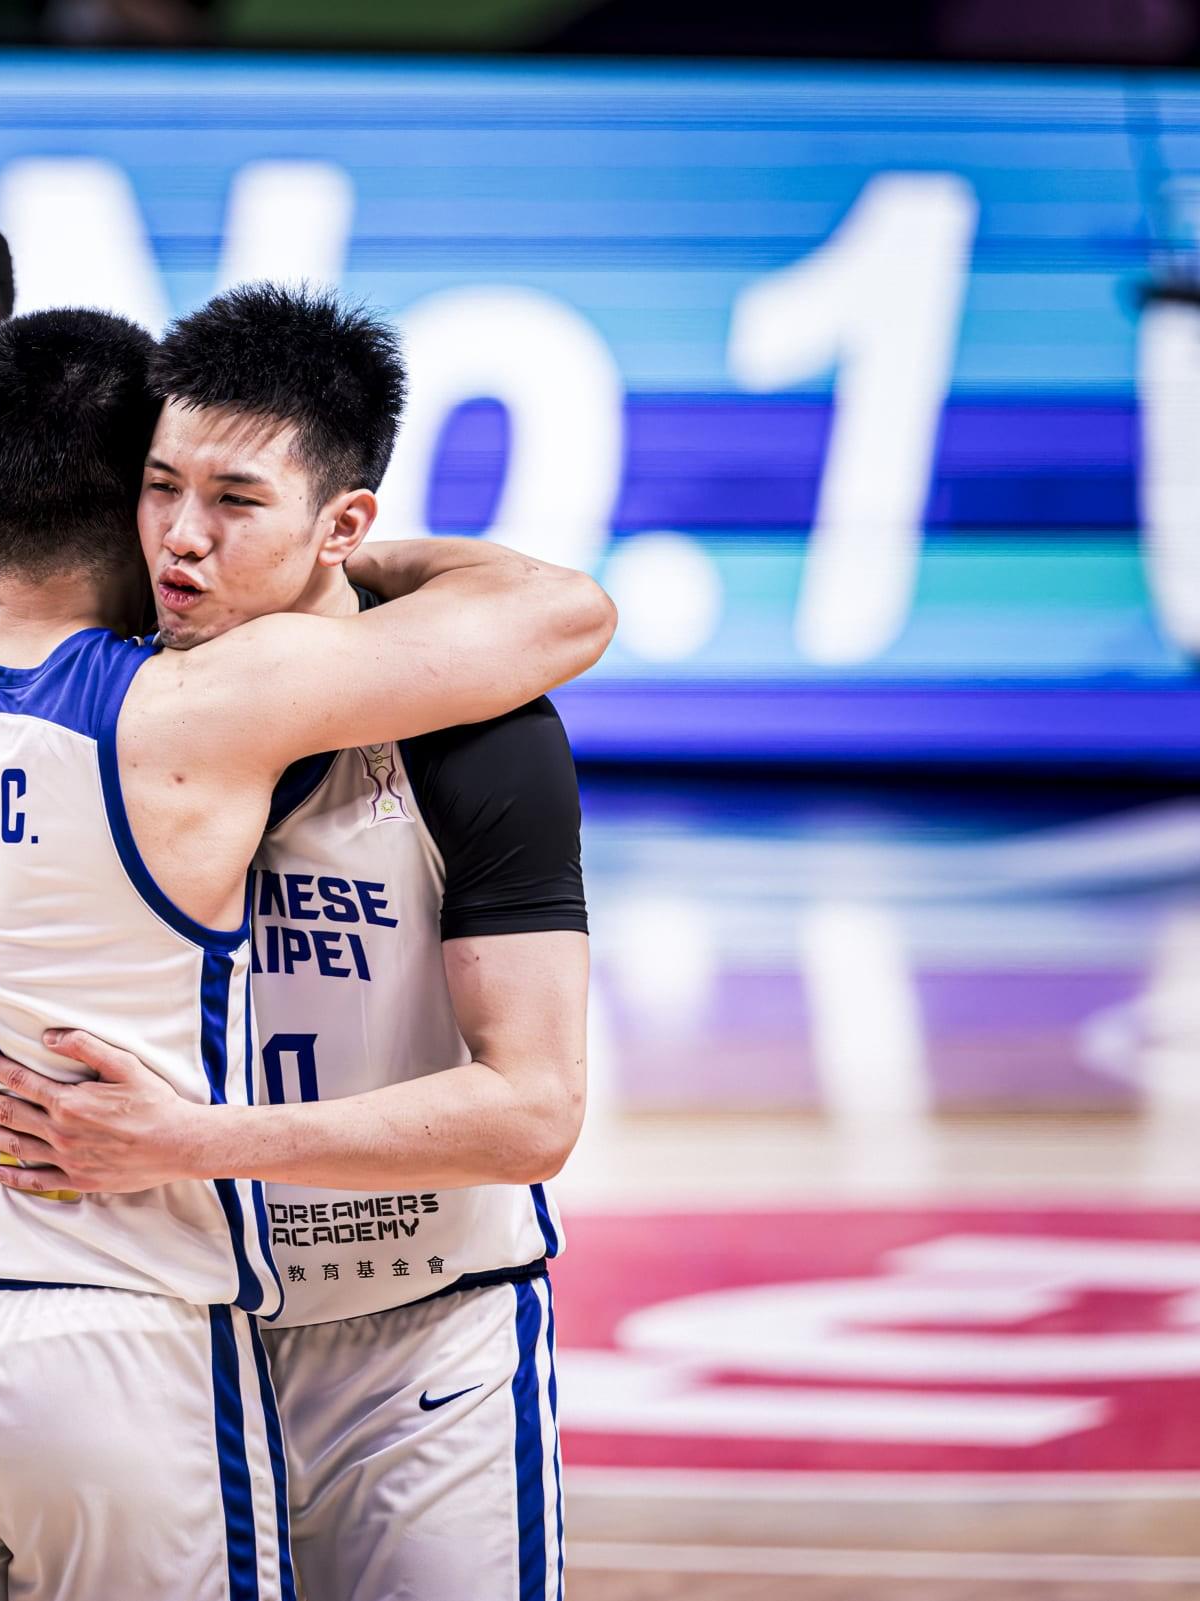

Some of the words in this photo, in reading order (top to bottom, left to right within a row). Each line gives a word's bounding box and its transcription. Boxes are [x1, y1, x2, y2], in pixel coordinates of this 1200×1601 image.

[267, 1193, 440, 1224] DREAMERS
[272, 1218, 419, 1247] ACADEMY
[288, 1255, 445, 1282] 教育基金會
